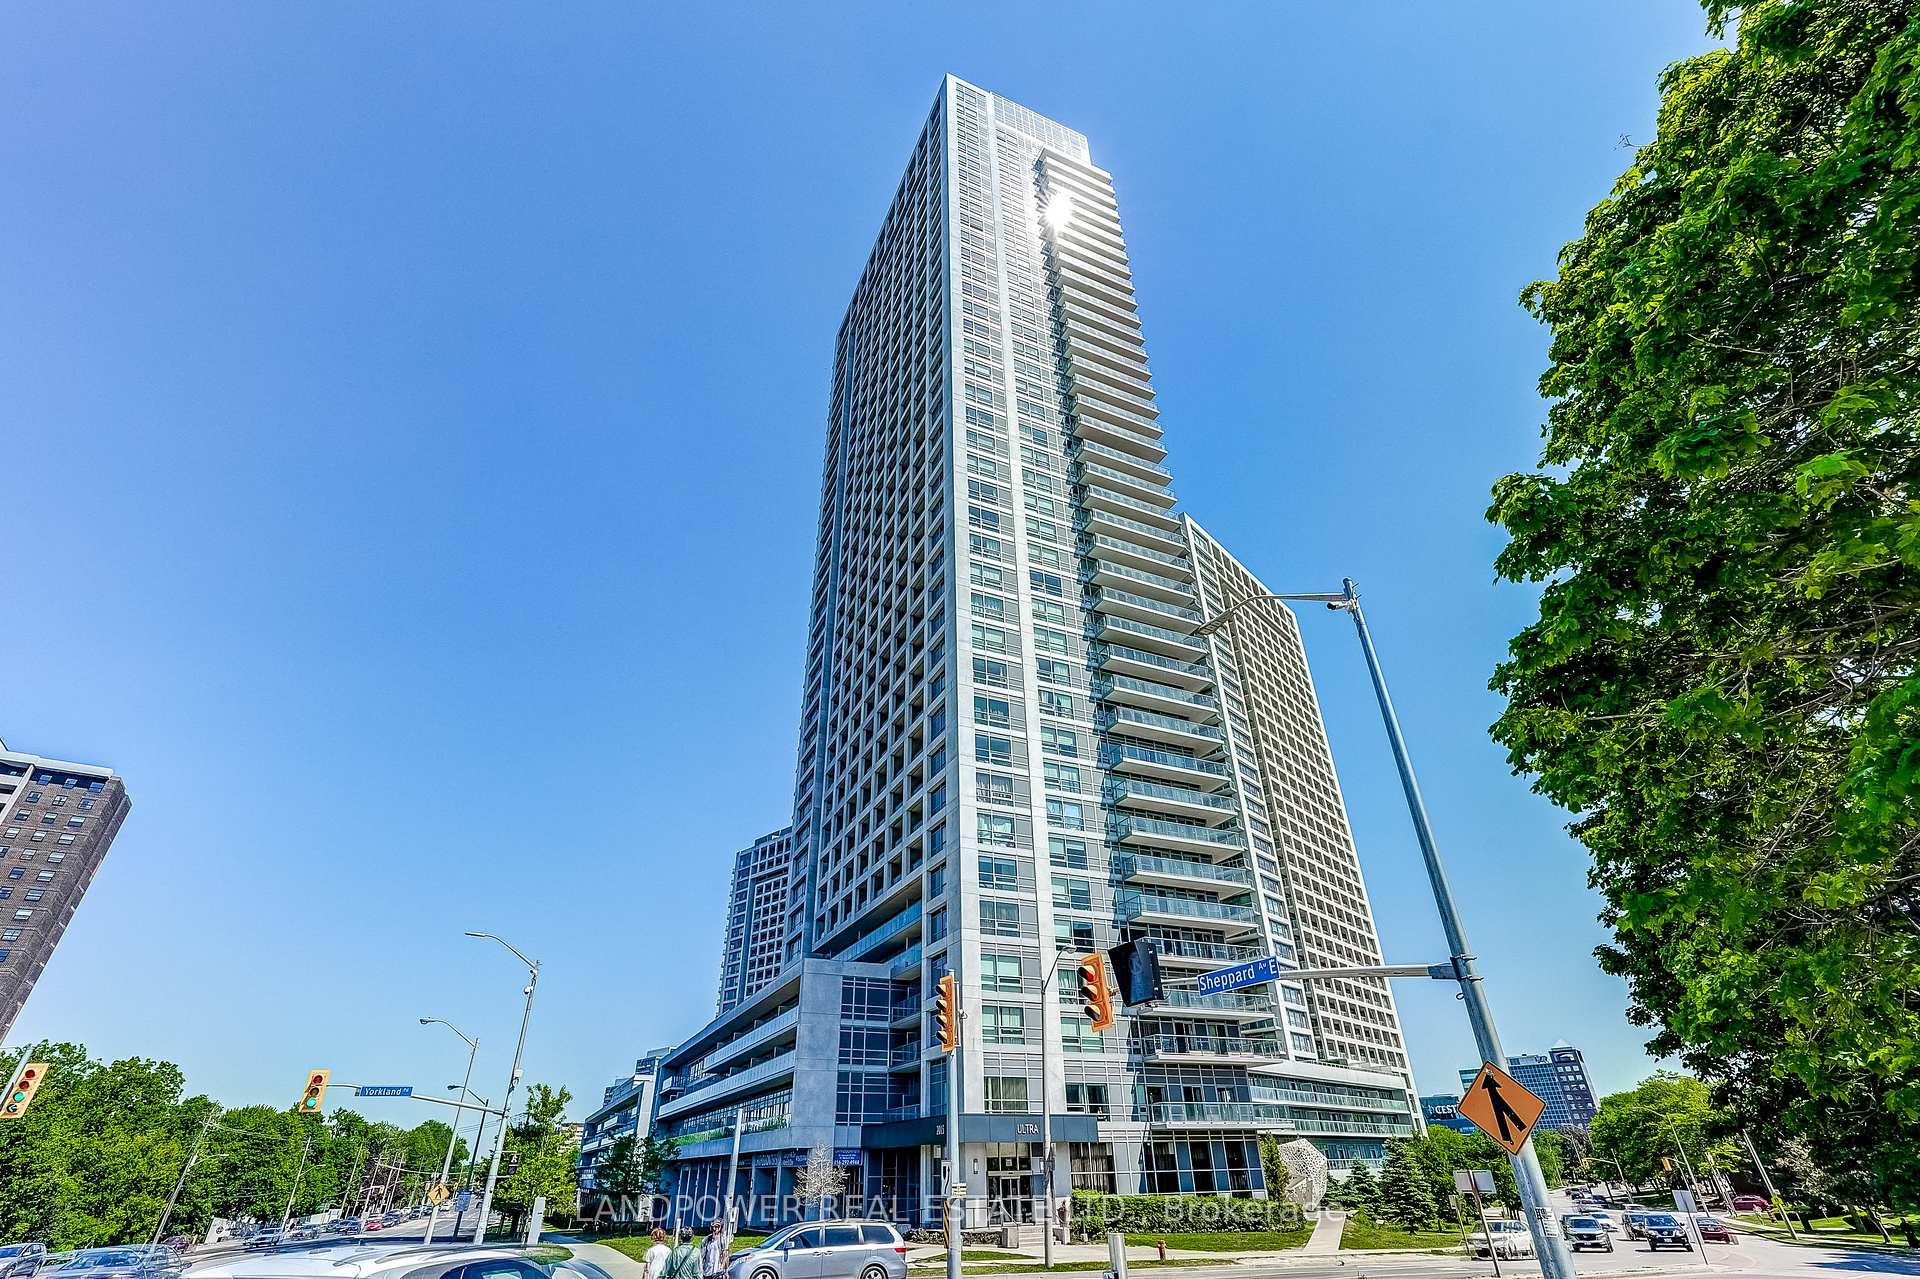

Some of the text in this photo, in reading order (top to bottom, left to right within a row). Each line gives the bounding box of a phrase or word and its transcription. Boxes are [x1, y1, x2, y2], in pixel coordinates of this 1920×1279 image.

[1200, 965, 1255, 991] Sheppard
[1269, 959, 1277, 975] E
[365, 1087, 402, 1096] Yorkland
[1016, 1123, 1039, 1135] ULTRA
